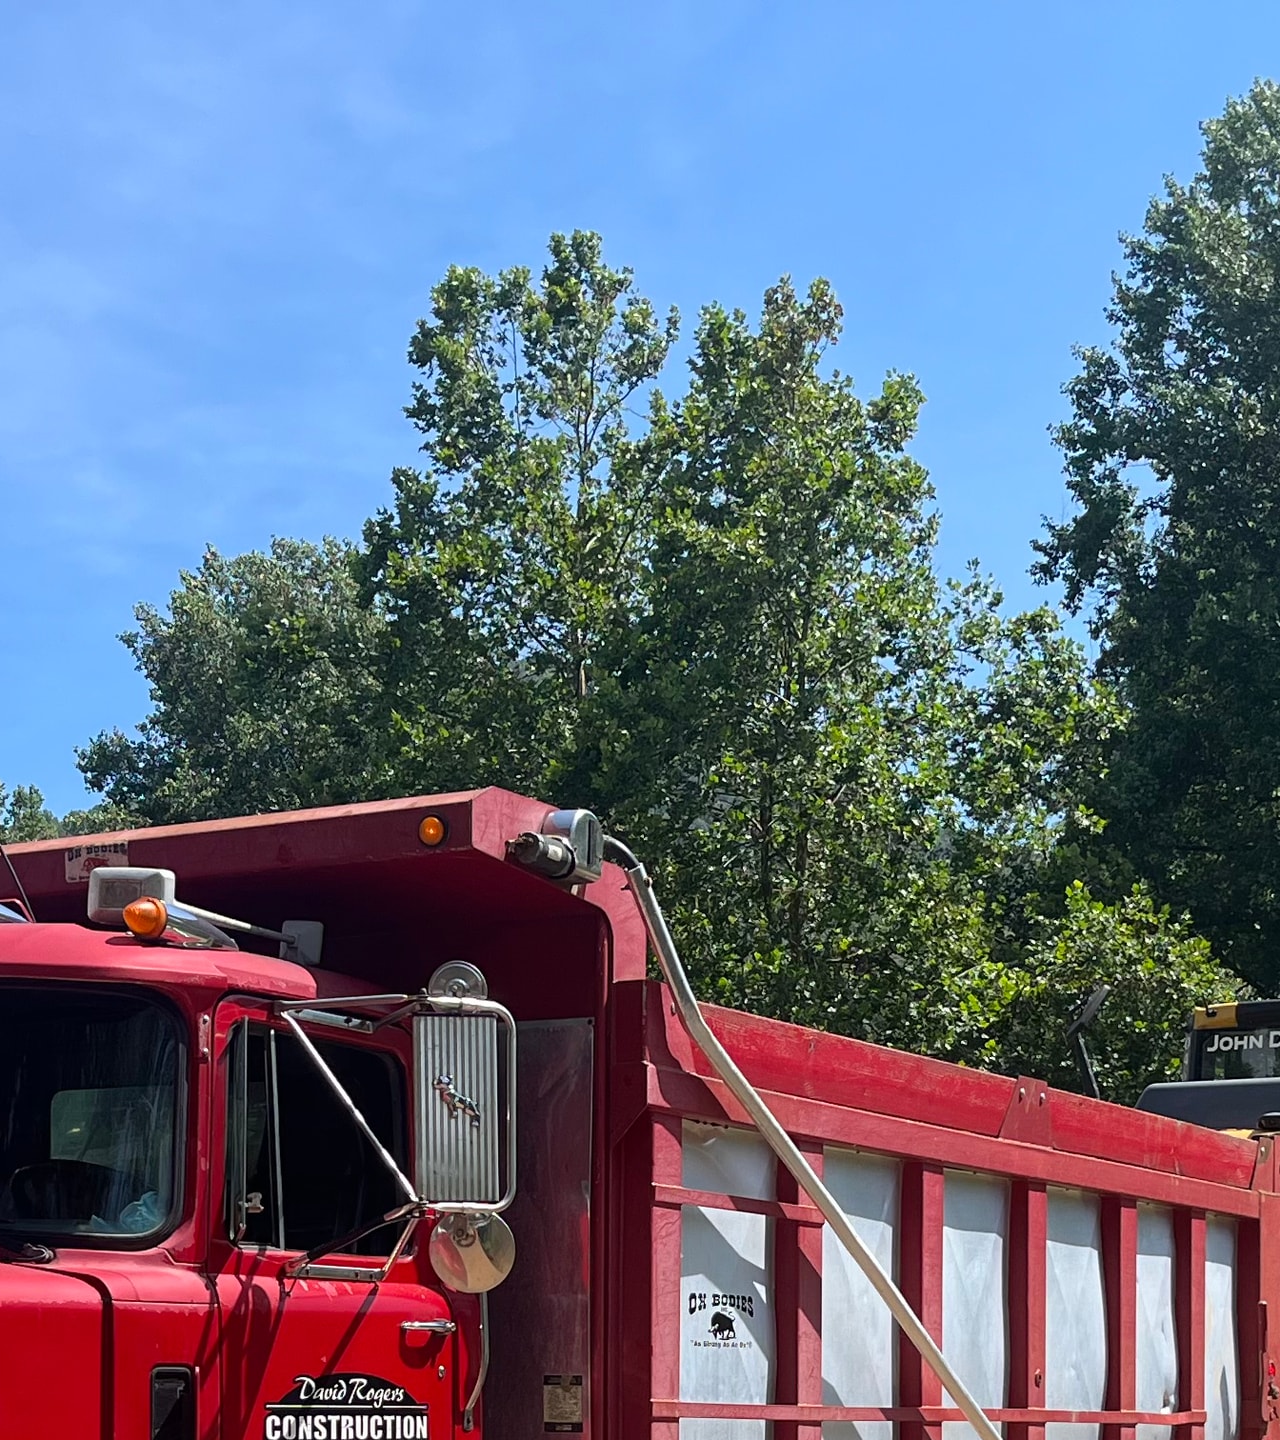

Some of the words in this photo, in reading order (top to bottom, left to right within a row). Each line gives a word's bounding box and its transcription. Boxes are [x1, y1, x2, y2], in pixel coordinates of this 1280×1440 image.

[1207, 1034, 1263, 1052] JOHN
[688, 1292, 707, 1315] OX
[711, 1293, 754, 1318] BODIES
[294, 1376, 348, 1401] David
[347, 1378, 405, 1408] Rogers
[265, 1414, 428, 1440] CONSTRUCTION
